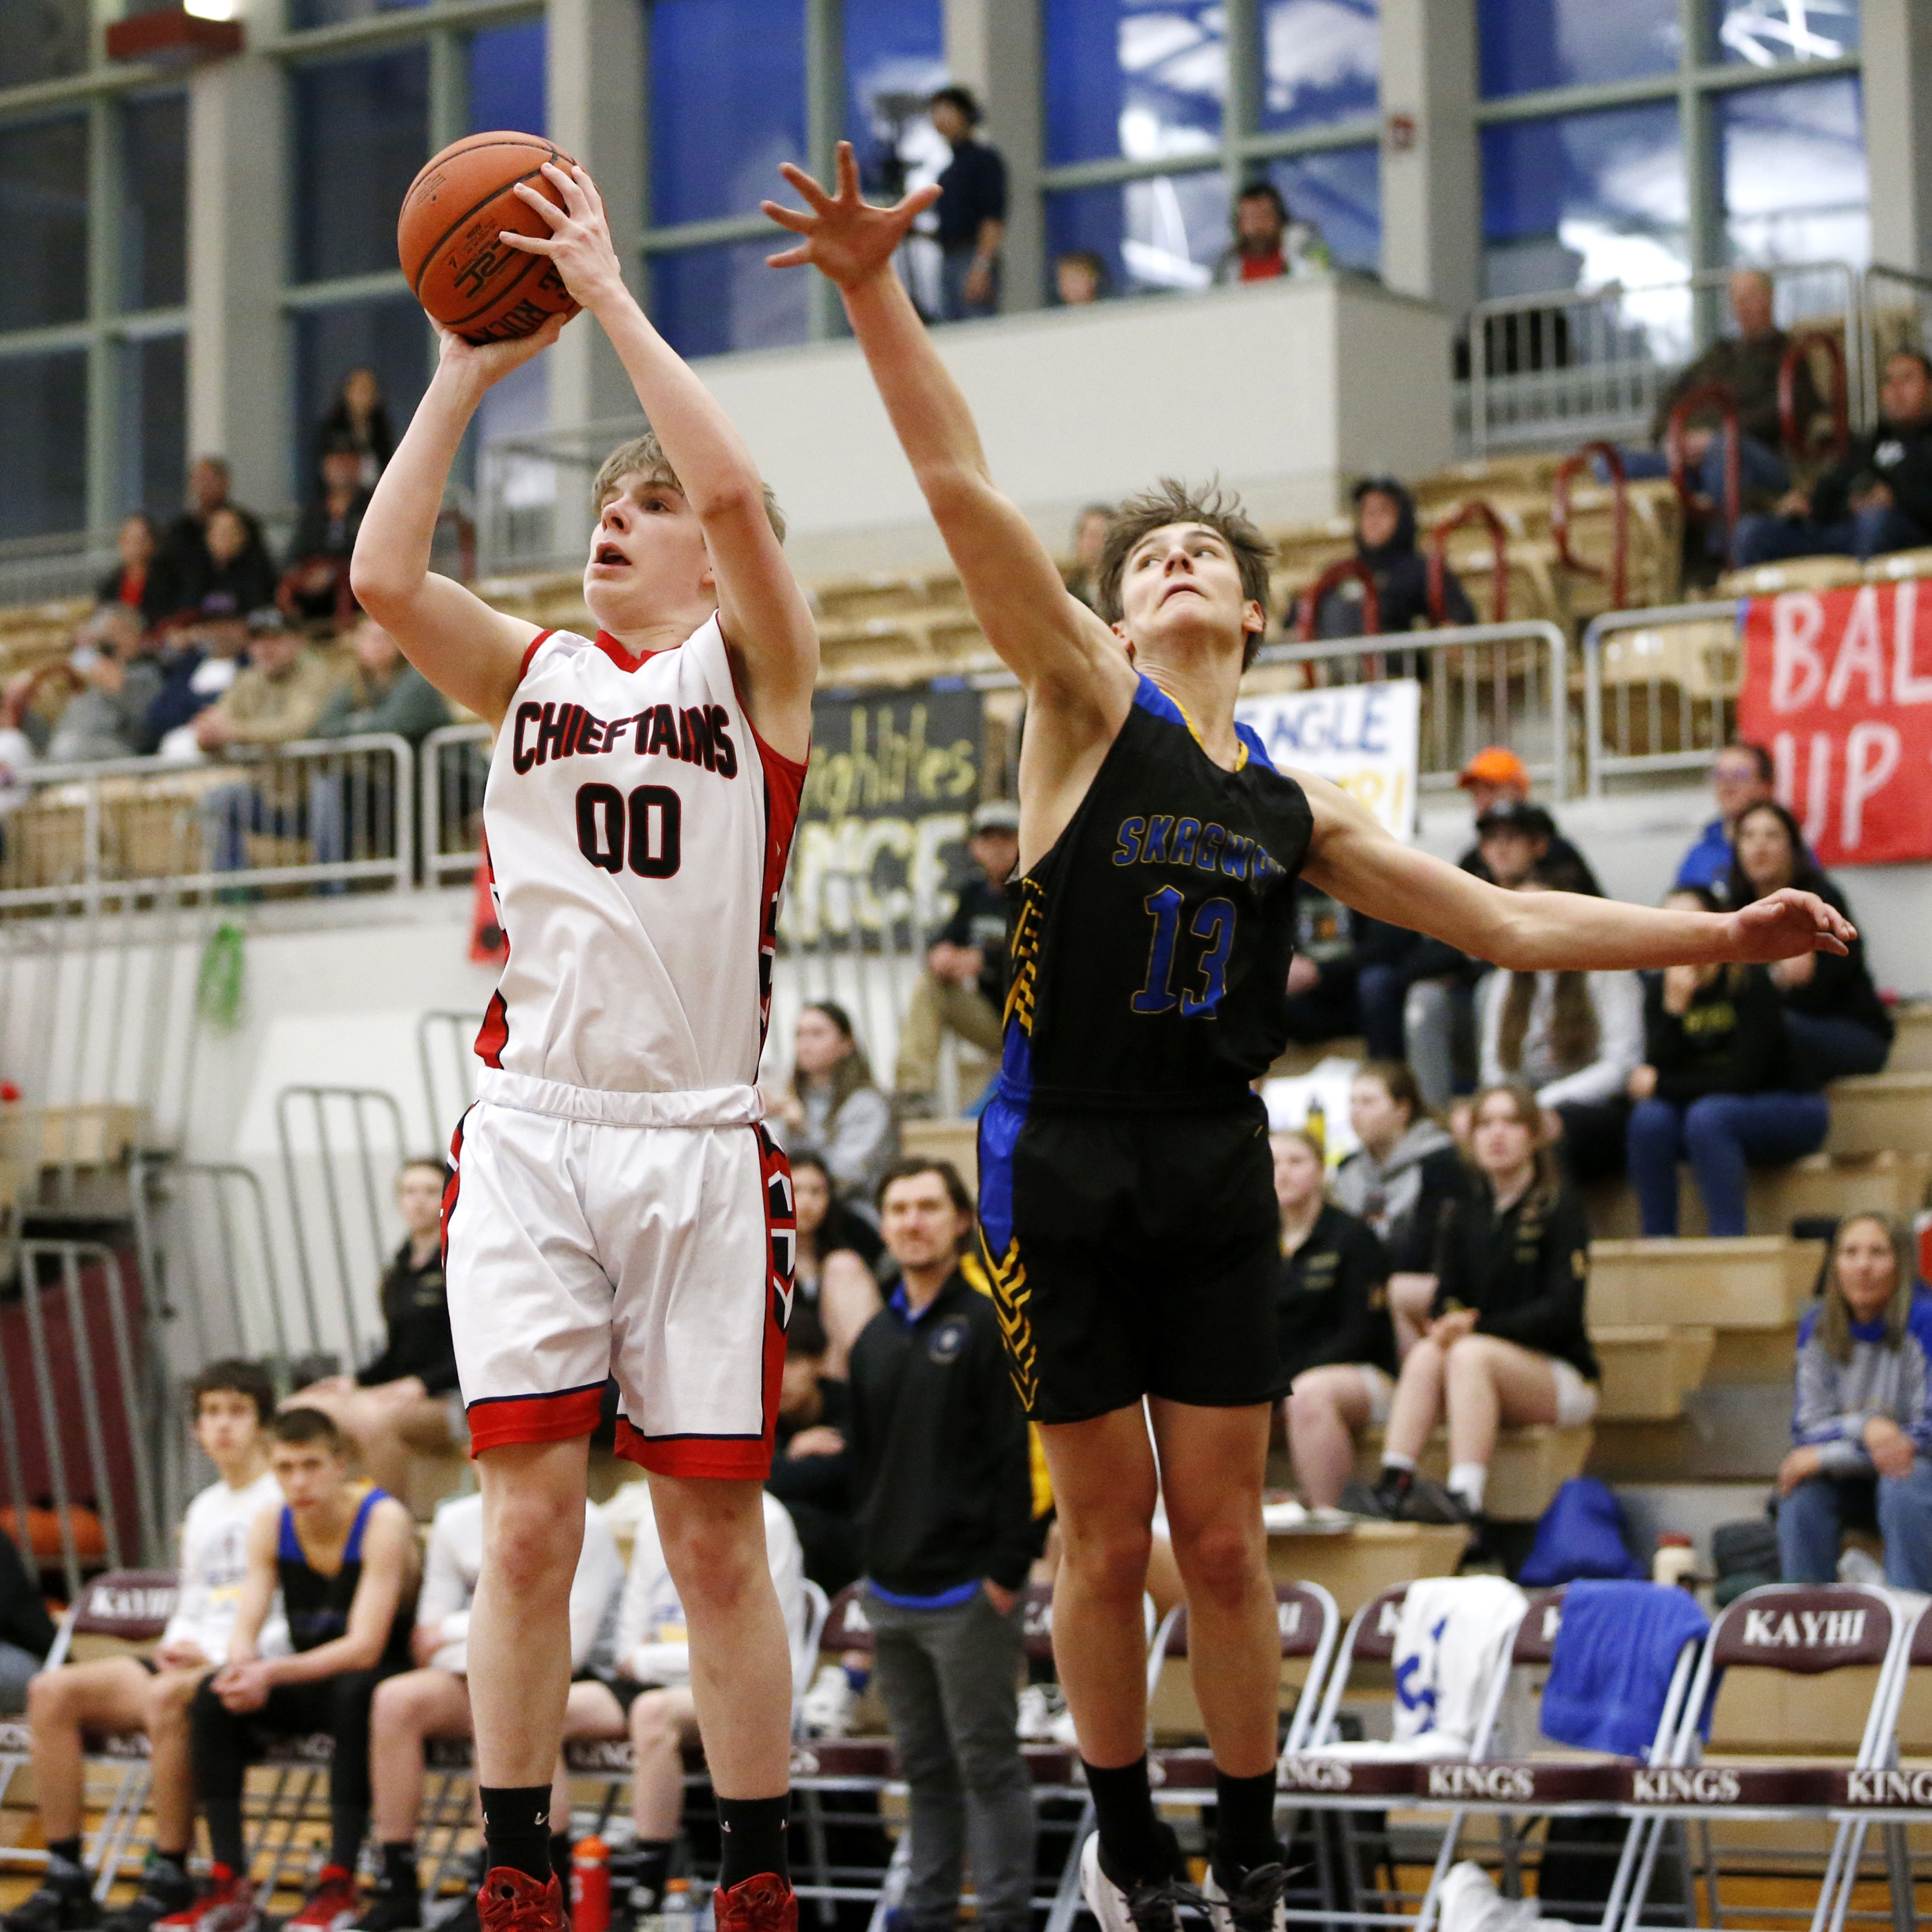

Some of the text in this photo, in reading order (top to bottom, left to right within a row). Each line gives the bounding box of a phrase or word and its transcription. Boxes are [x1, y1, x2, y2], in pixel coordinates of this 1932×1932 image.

[1771, 580, 1932, 714] BAL
[513, 701, 738, 780] CHIEFTAINS
[1773, 721, 1902, 851] UP
[576, 783, 681, 879] 00
[1131, 885, 1237, 1019] 13
[1742, 1608, 1868, 1647] KAYHI
[1428, 1765, 1535, 1800] KINGS
[1632, 1769, 1741, 1803] KINGS
